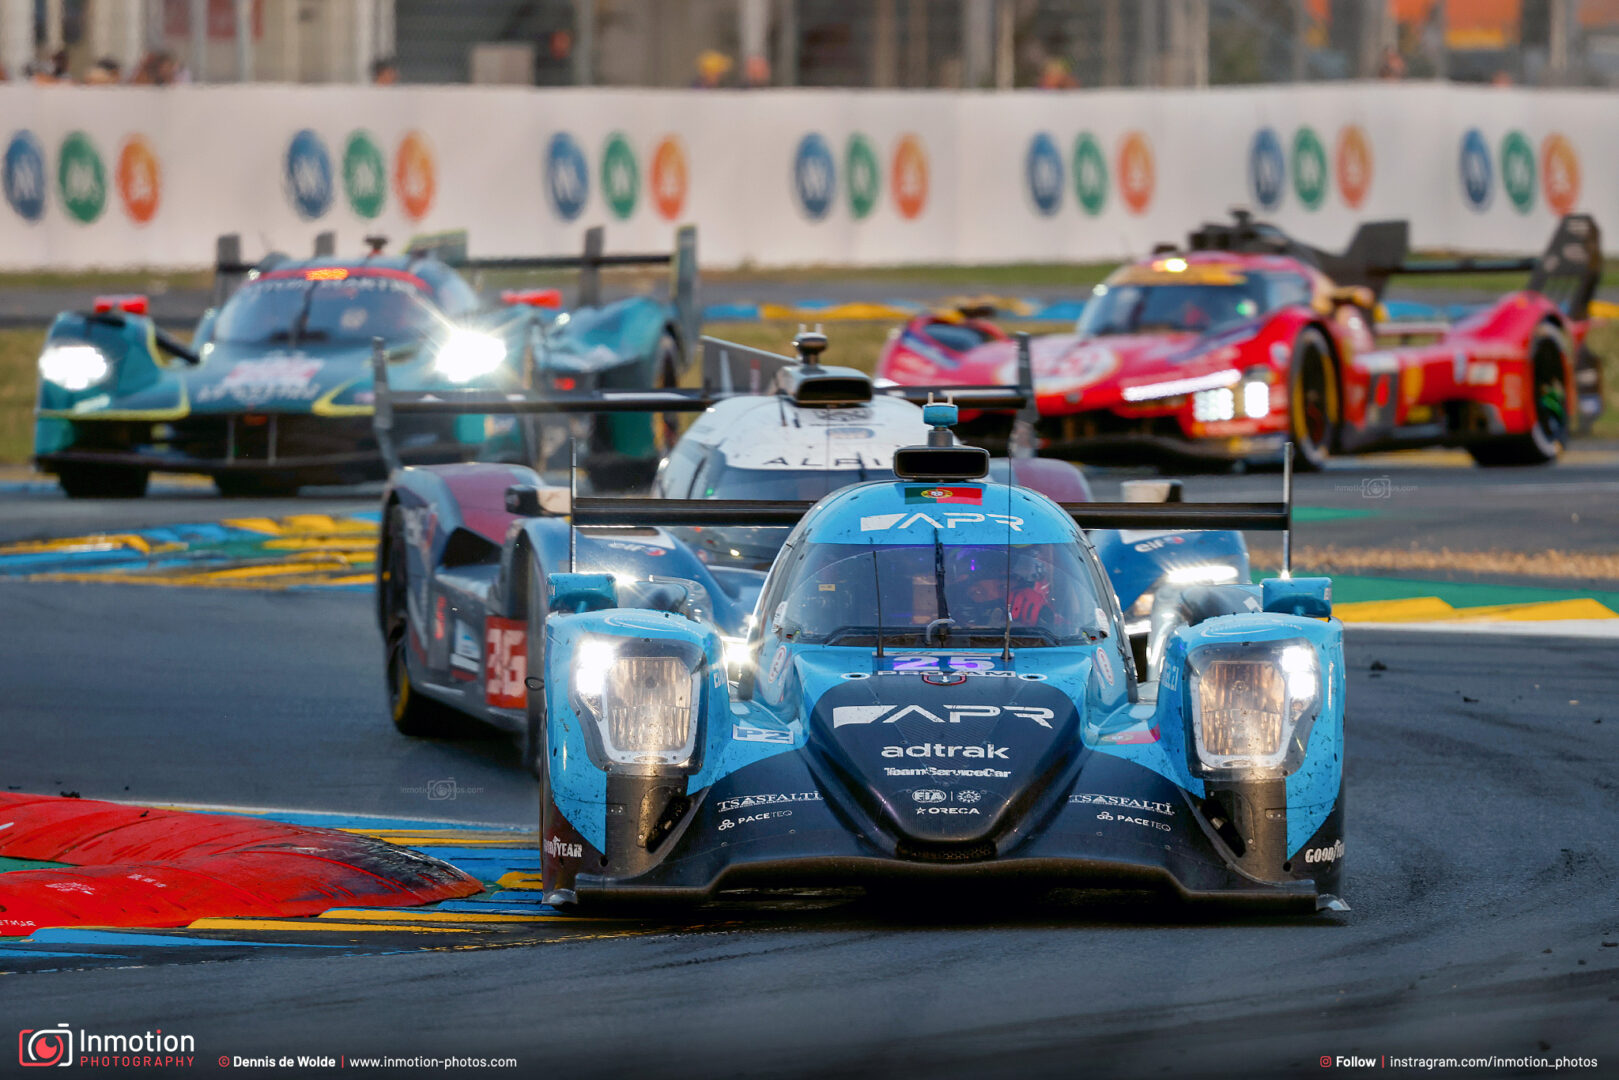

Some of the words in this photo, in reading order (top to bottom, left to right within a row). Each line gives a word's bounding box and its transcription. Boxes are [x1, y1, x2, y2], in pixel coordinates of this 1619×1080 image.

[762, 456, 883, 467] ALPI
[861, 512, 1024, 532] APR
[486, 629, 526, 697] 36
[893, 655, 996, 671] 25
[833, 704, 1055, 729] APR
[881, 743, 1010, 760] adtrak
[913, 790, 945, 802] FIA
[928, 807, 981, 815] ORECA
